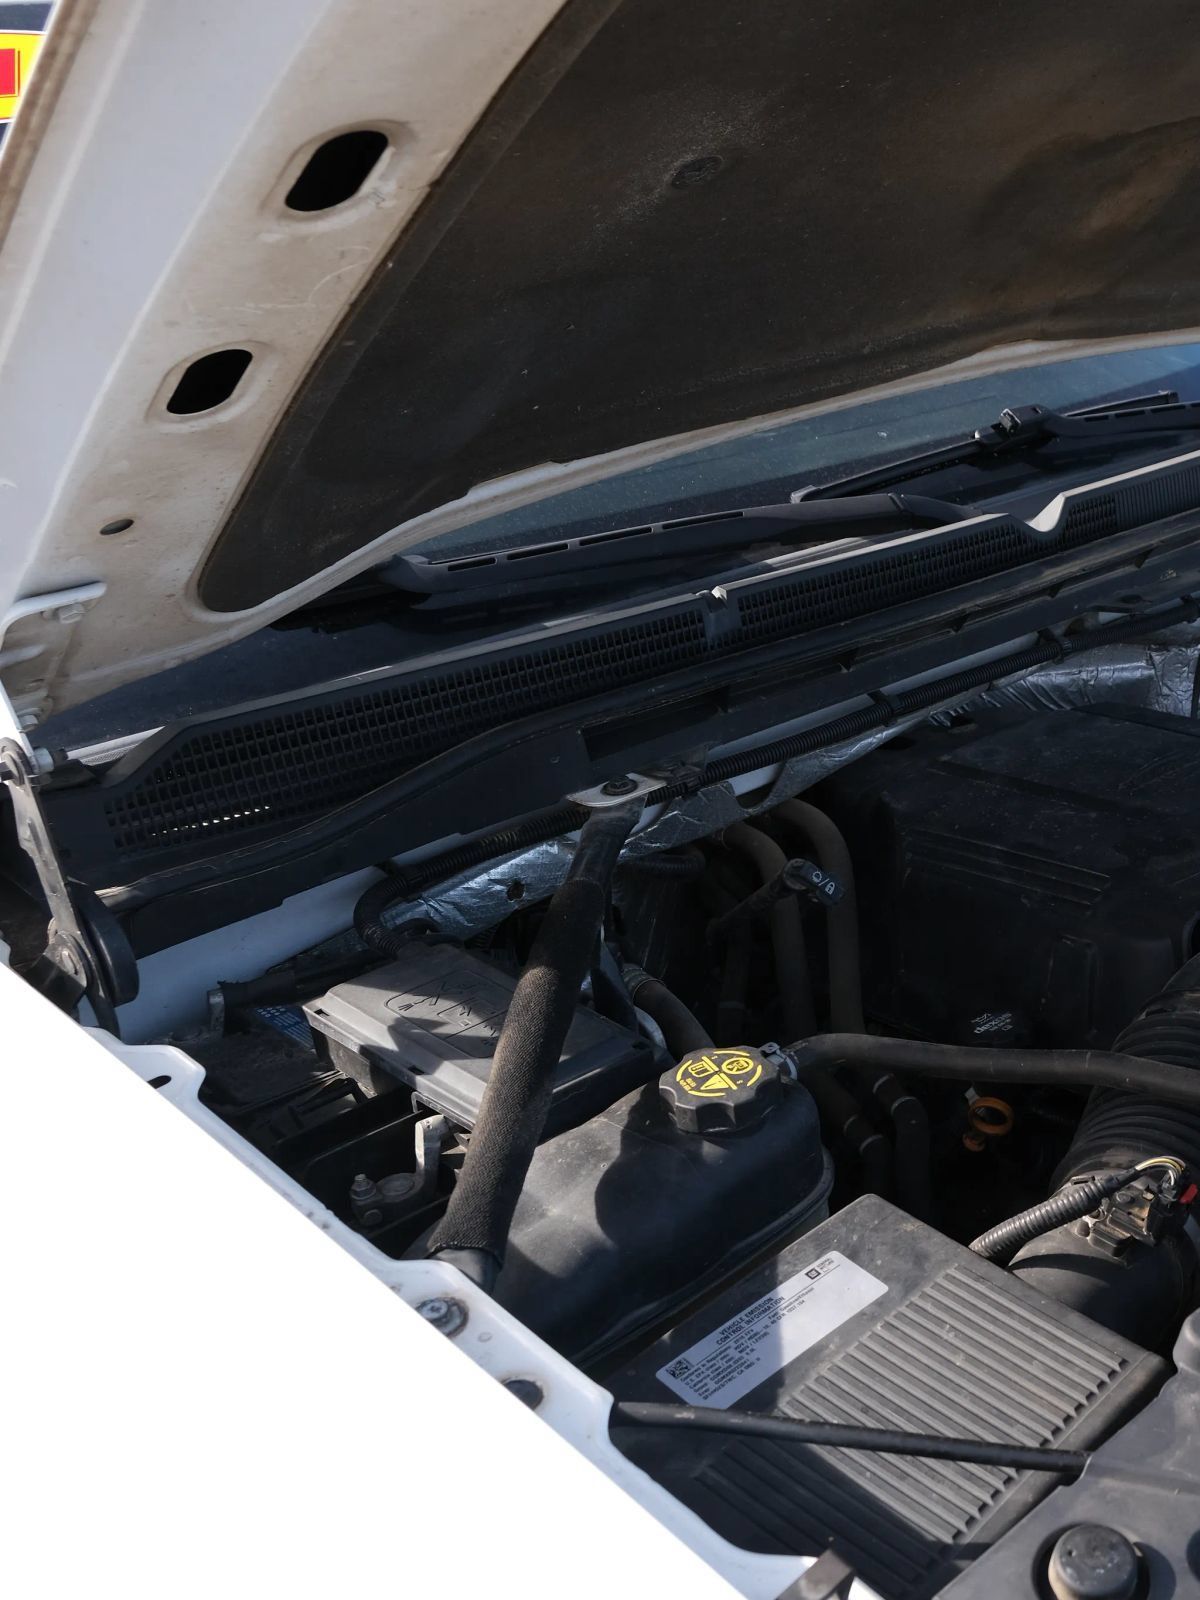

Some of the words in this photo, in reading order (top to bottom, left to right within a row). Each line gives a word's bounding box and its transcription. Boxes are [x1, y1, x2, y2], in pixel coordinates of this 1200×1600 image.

[715, 1324, 745, 1345] CONTROL
[743, 1295, 786, 1325] INFORMATION
[718, 1316, 745, 1335] VEHICLE
[743, 1296, 774, 1317] EMISSION
